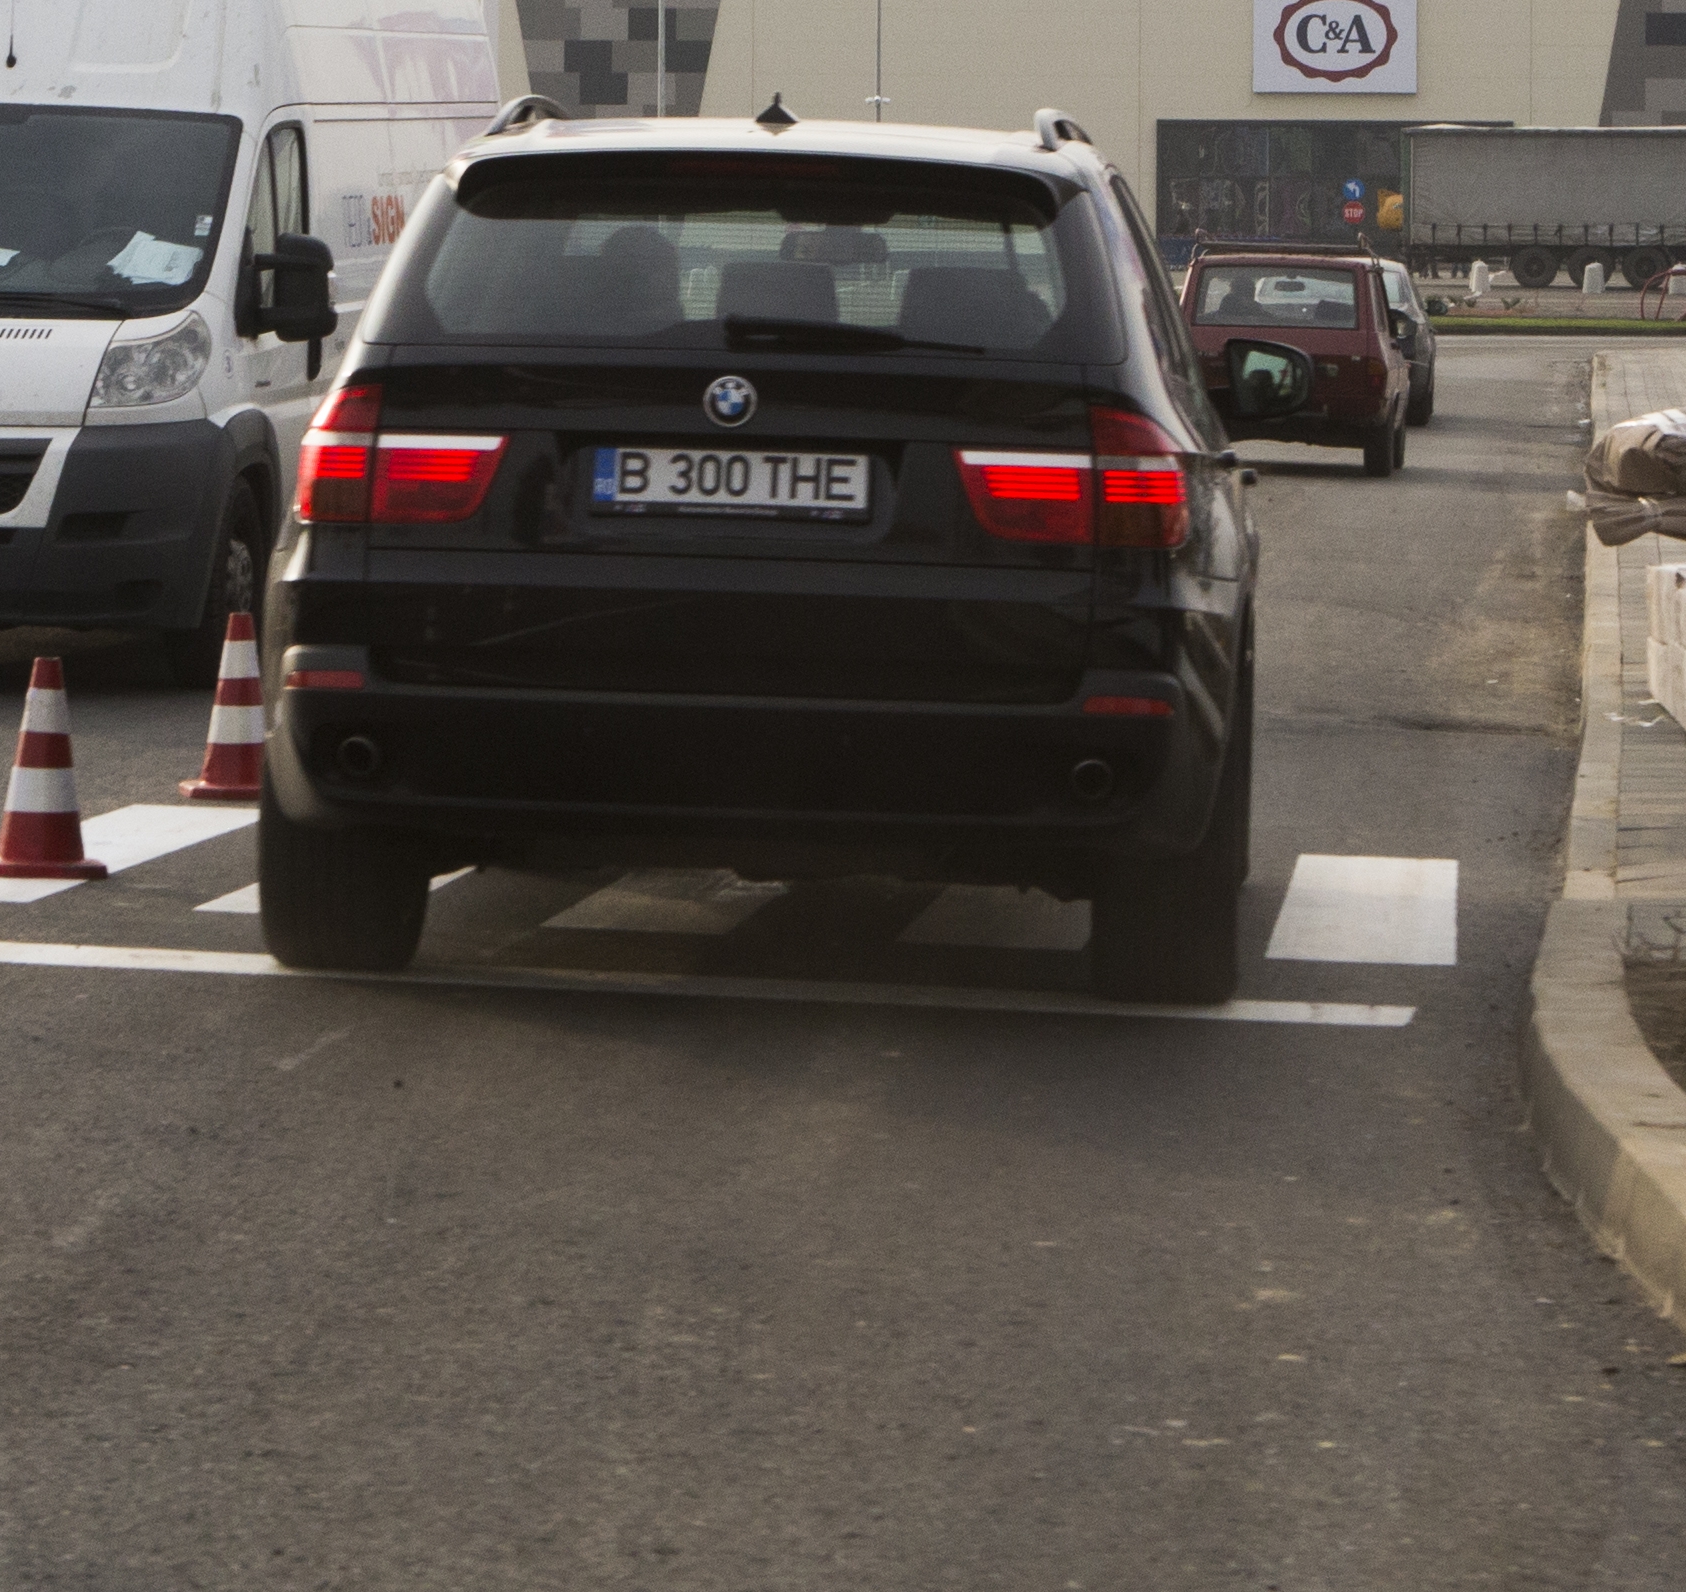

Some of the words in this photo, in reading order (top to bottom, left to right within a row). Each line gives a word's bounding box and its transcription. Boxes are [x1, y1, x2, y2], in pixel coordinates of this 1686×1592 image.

[1296, 14, 1376, 54] C&A
[1344, 208, 1364, 218] STOP
[619, 451, 650, 495] B
[669, 453, 751, 497] 300
[763, 456, 858, 502] THE
